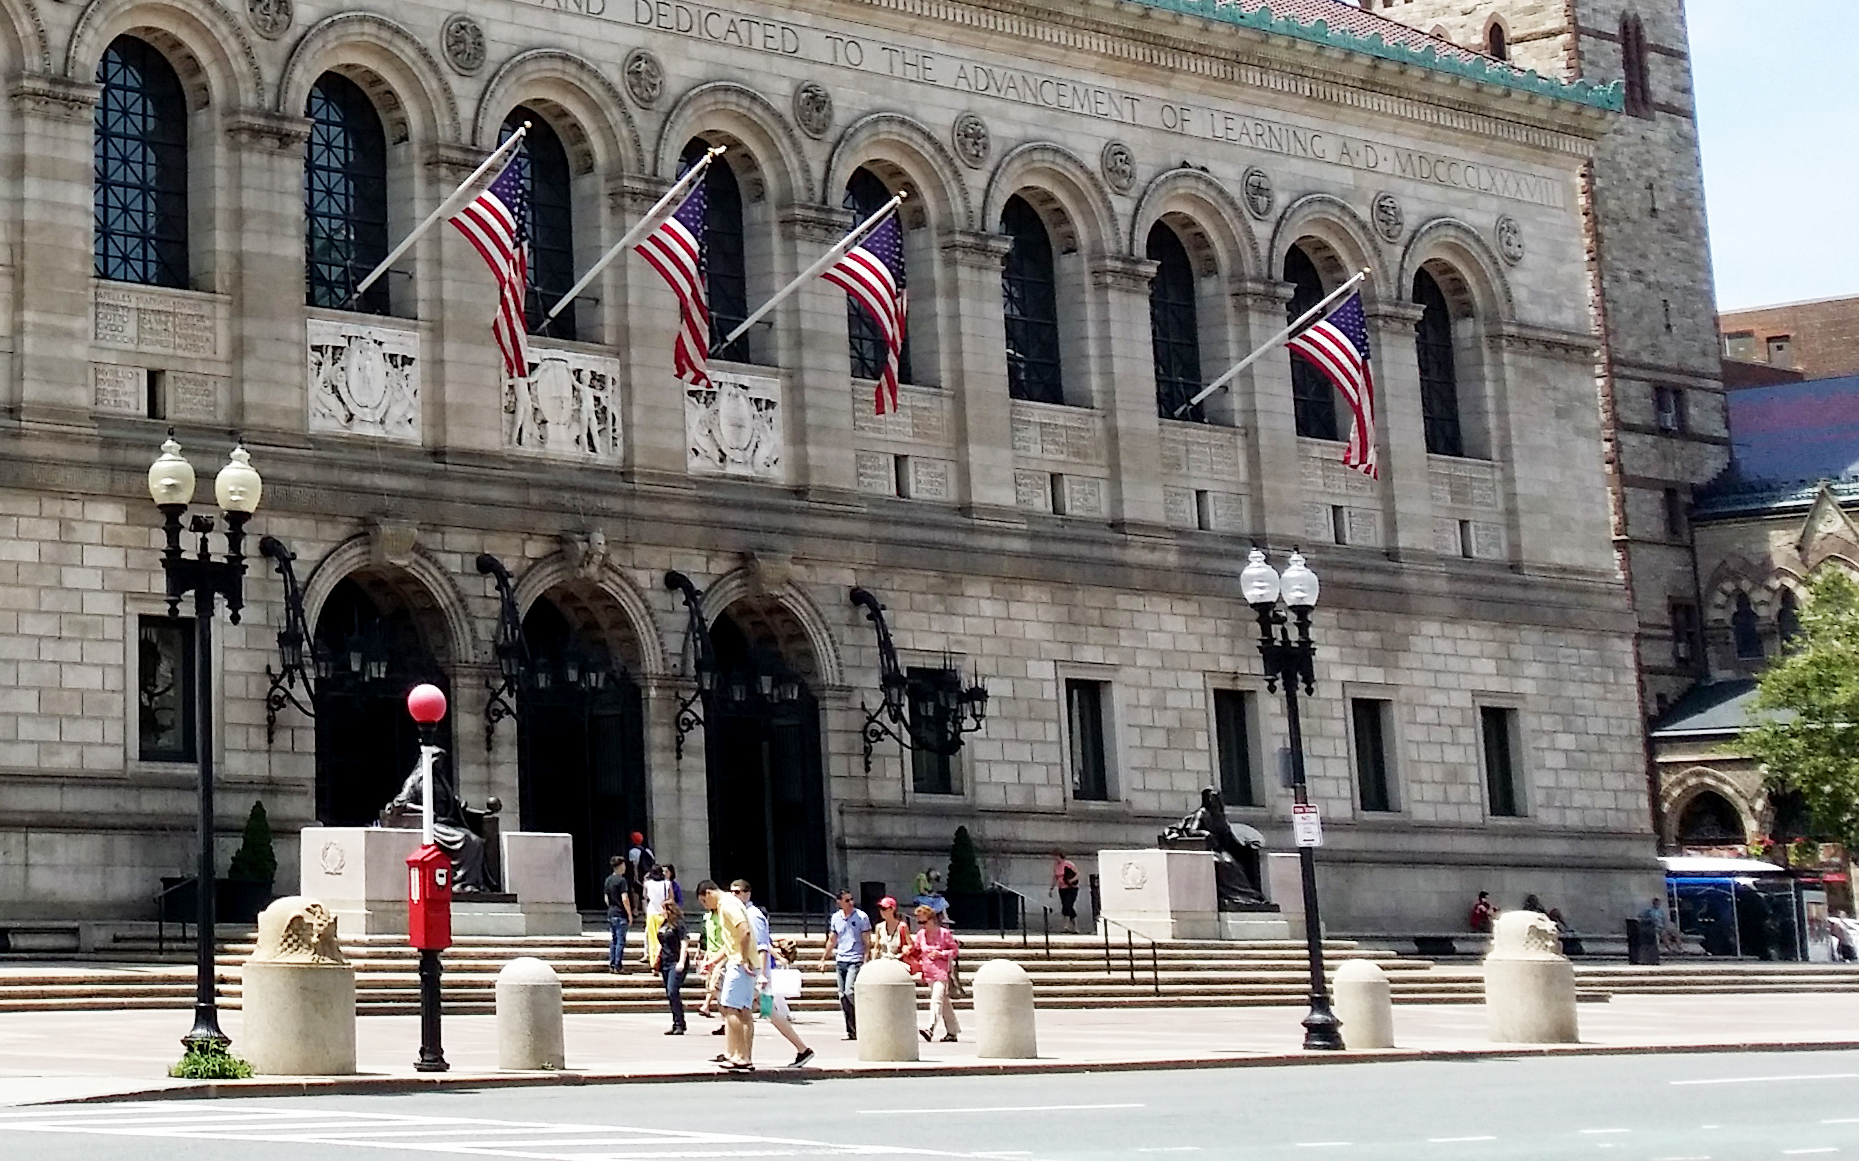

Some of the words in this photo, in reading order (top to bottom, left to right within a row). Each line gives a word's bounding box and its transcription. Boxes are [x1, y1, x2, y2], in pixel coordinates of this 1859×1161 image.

[823, 34, 864, 68] TO
[881, 46, 938, 84] THE
[956, 64, 1141, 124] ADVANCEMENT
[1161, 103, 1191, 132] OF
[1209, 112, 1327, 161] LEARNING
